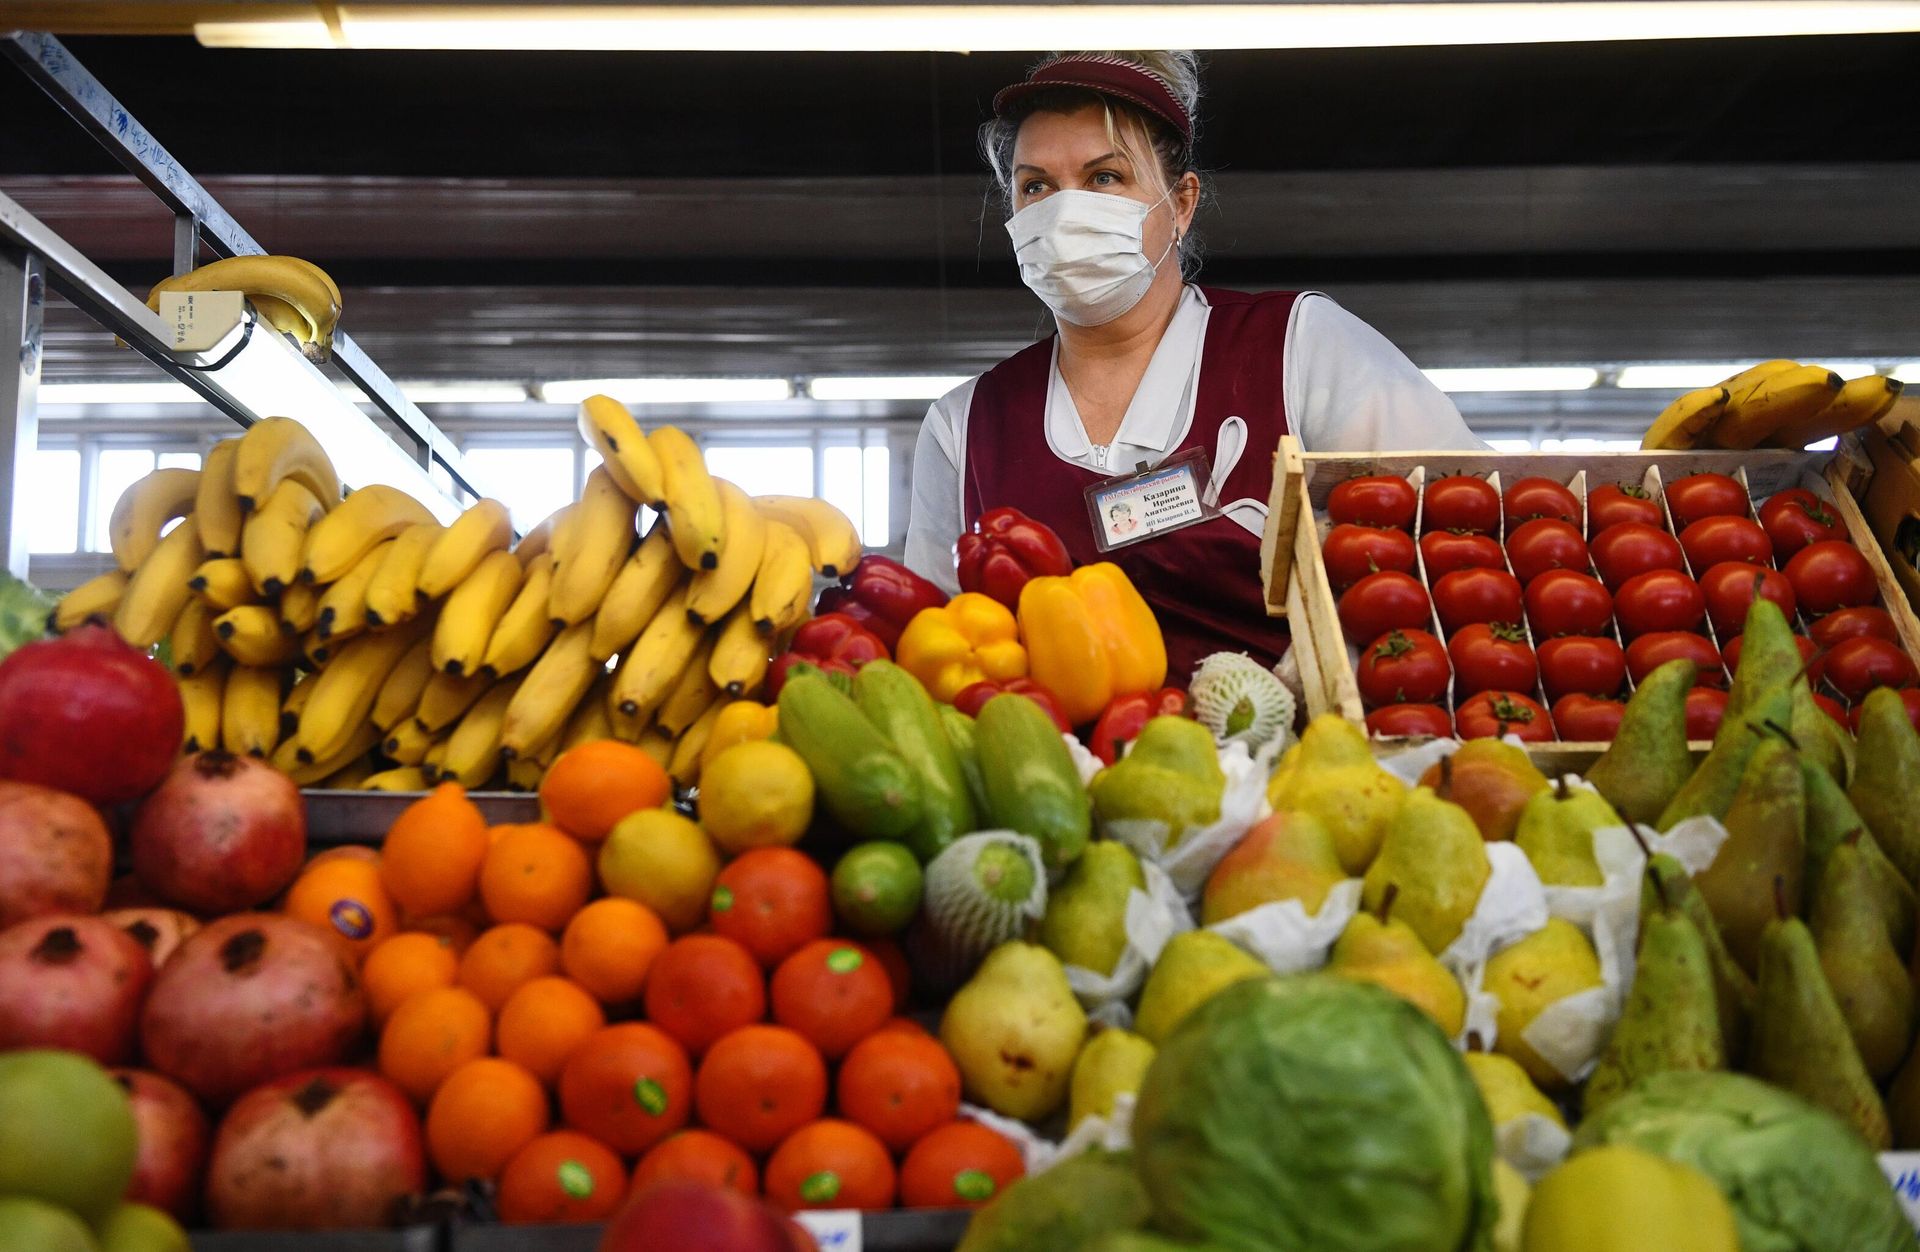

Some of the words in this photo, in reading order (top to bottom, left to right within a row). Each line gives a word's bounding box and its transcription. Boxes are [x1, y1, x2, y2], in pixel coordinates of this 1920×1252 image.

[1143, 483, 1186, 502] Казарина
[1143, 499, 1194, 518] Анатольевна
[1152, 495, 1180, 508] Ирина
[1157, 512, 1184, 525] Казарина
